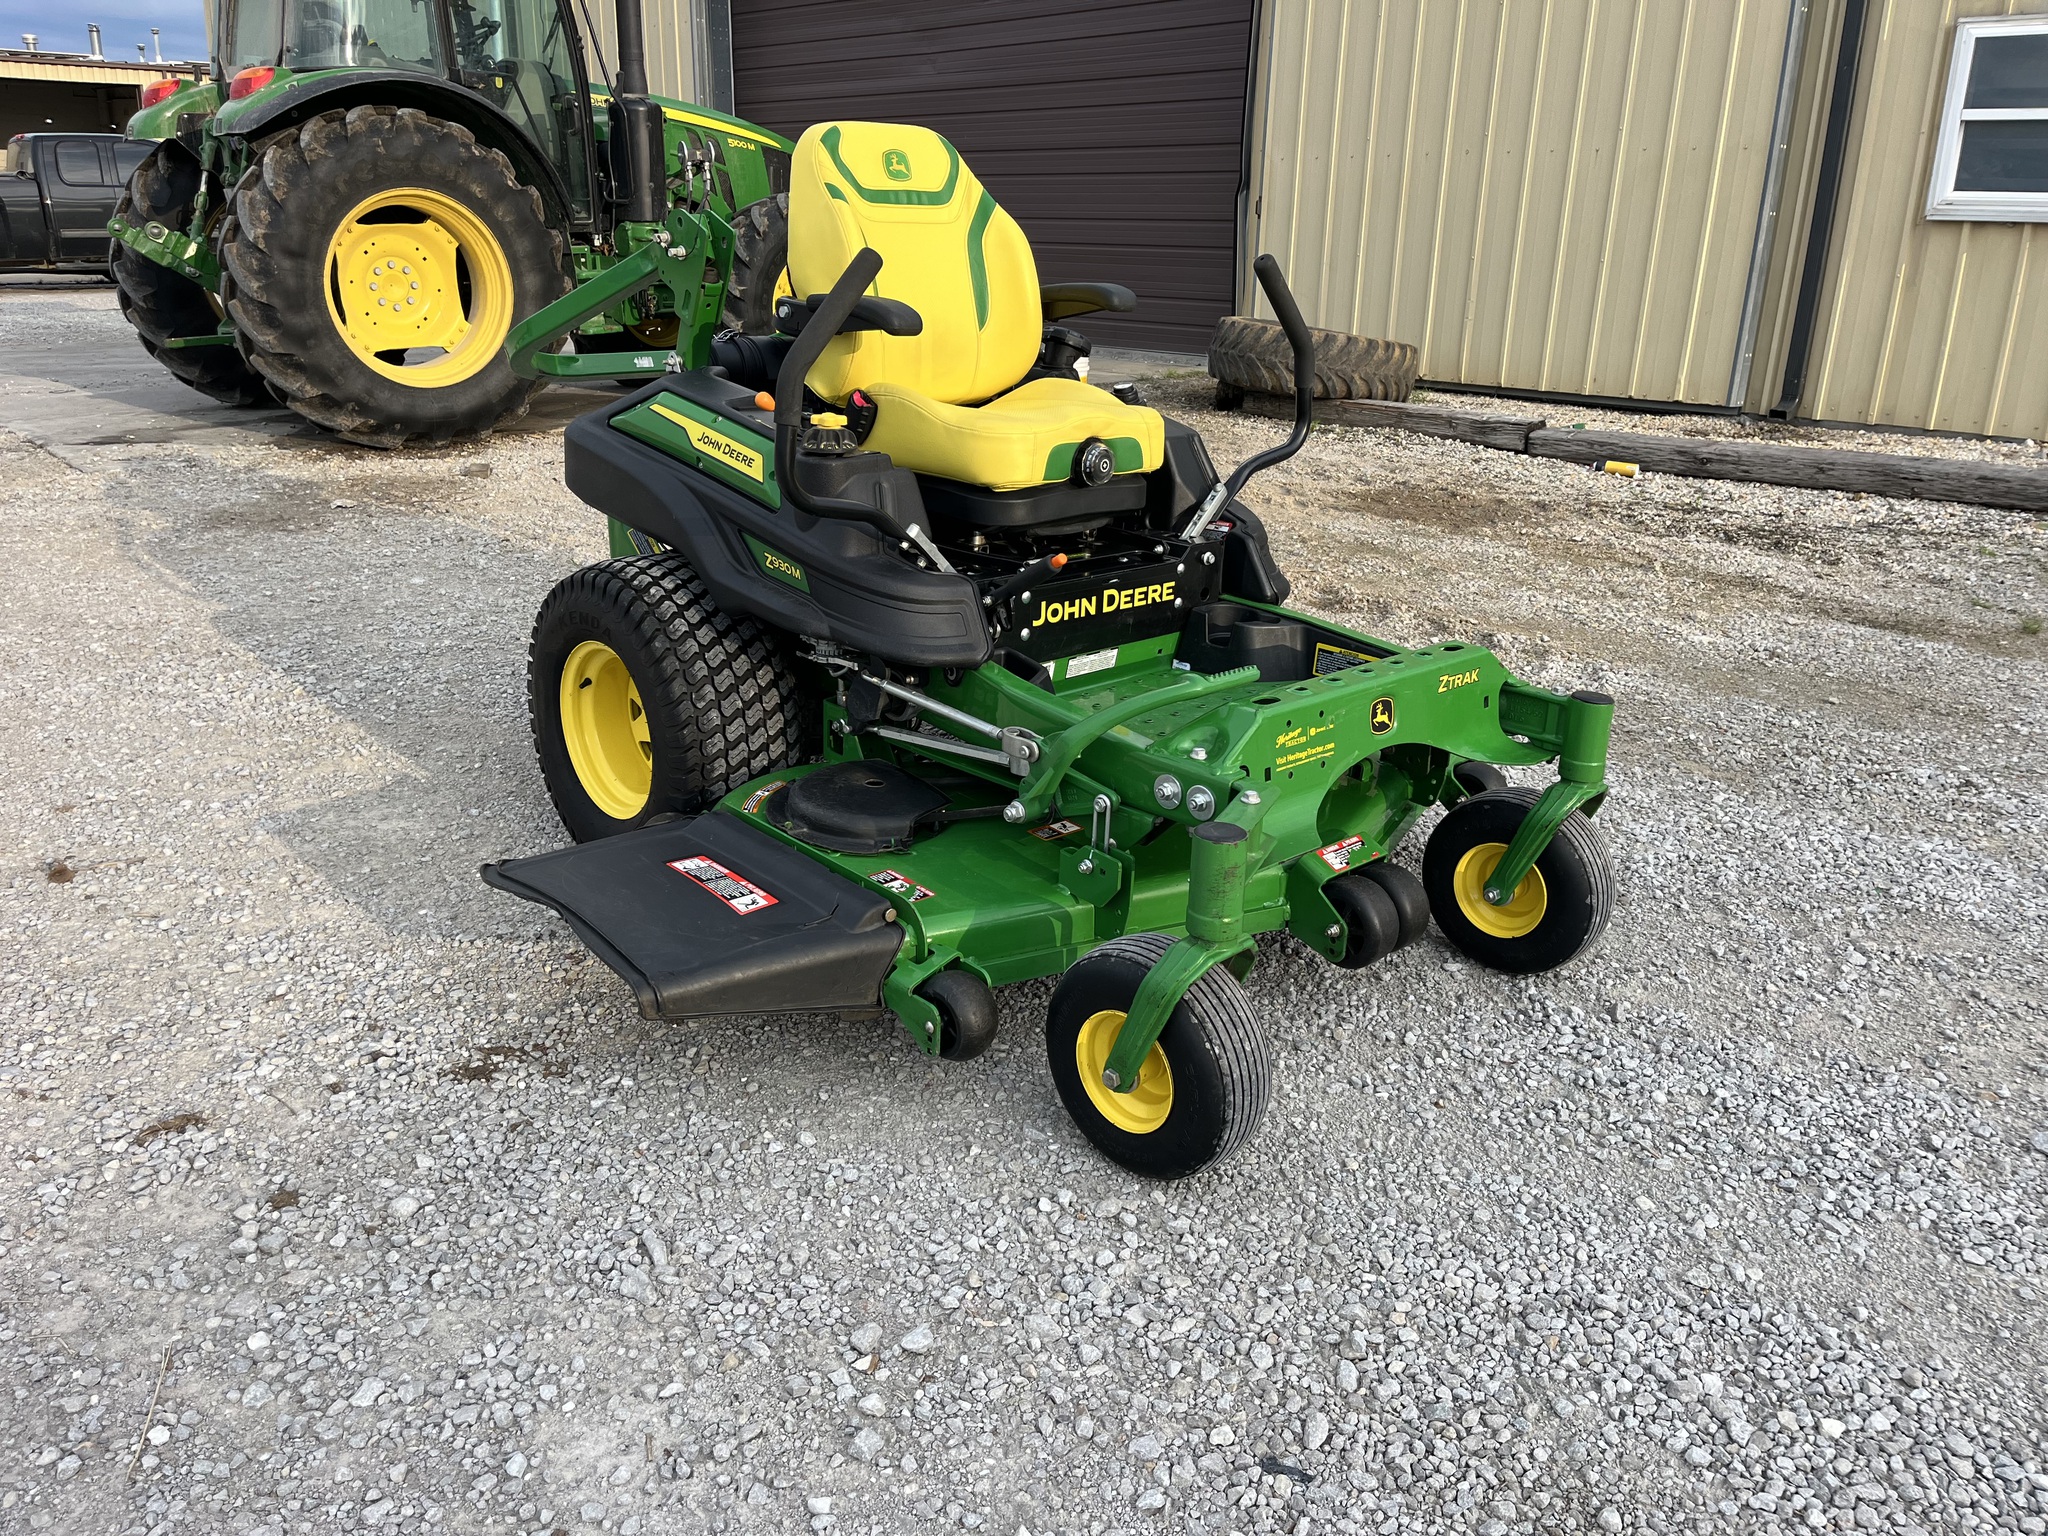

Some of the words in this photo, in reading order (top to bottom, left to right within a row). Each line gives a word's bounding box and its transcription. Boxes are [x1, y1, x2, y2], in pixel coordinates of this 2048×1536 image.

[697, 432, 722, 452] JOHN
[722, 443, 755, 468] DEERE
[764, 552, 801, 580] Z930M
[1032, 595, 1097, 627] JOHN
[1102, 581, 1176, 613] DEERE
[560, 610, 613, 642] KENDA
[1437, 668, 1480, 693] ZTRAK
[1287, 742, 1335, 762] HeritageTractor.com
